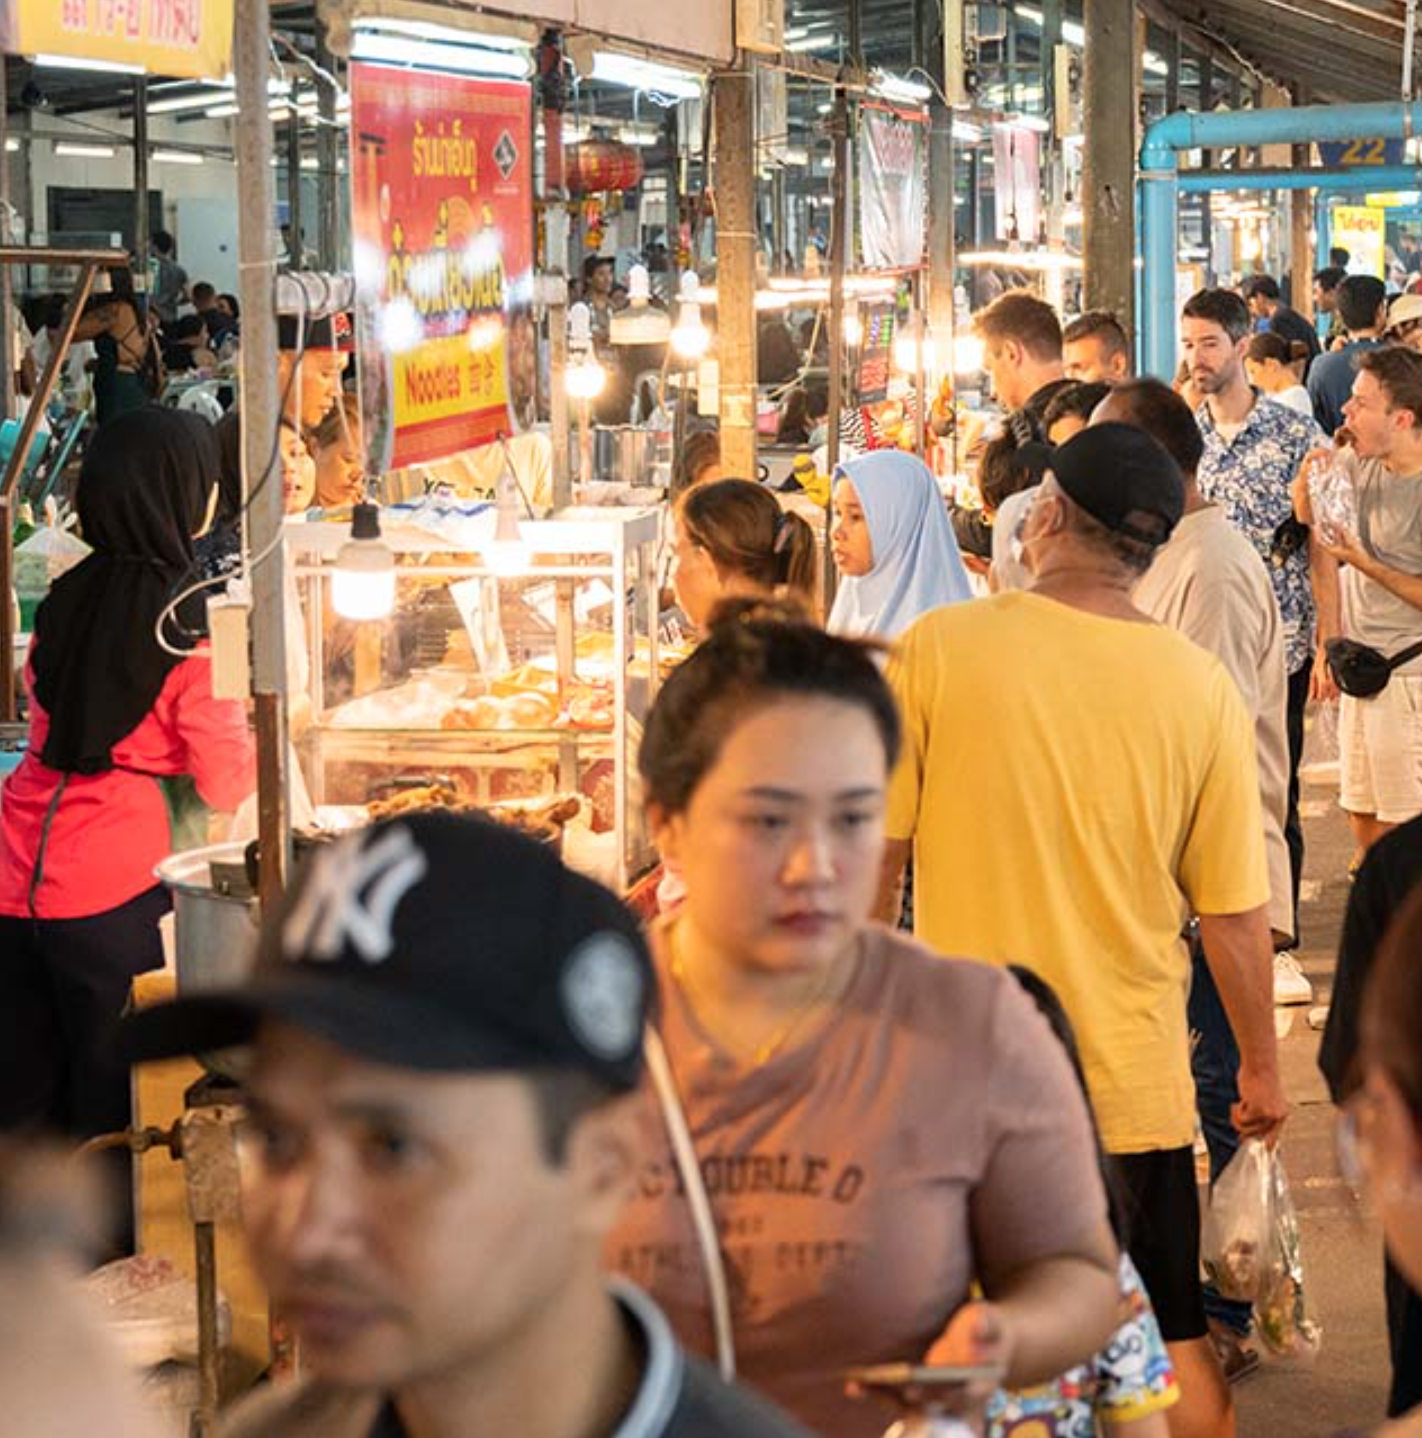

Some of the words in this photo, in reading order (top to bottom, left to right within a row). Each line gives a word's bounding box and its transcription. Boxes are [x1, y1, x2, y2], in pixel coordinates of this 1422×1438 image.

[1341, 137, 1385, 165] 22
[405, 360, 461, 406] Noodles
[281, 822, 428, 964] NY
